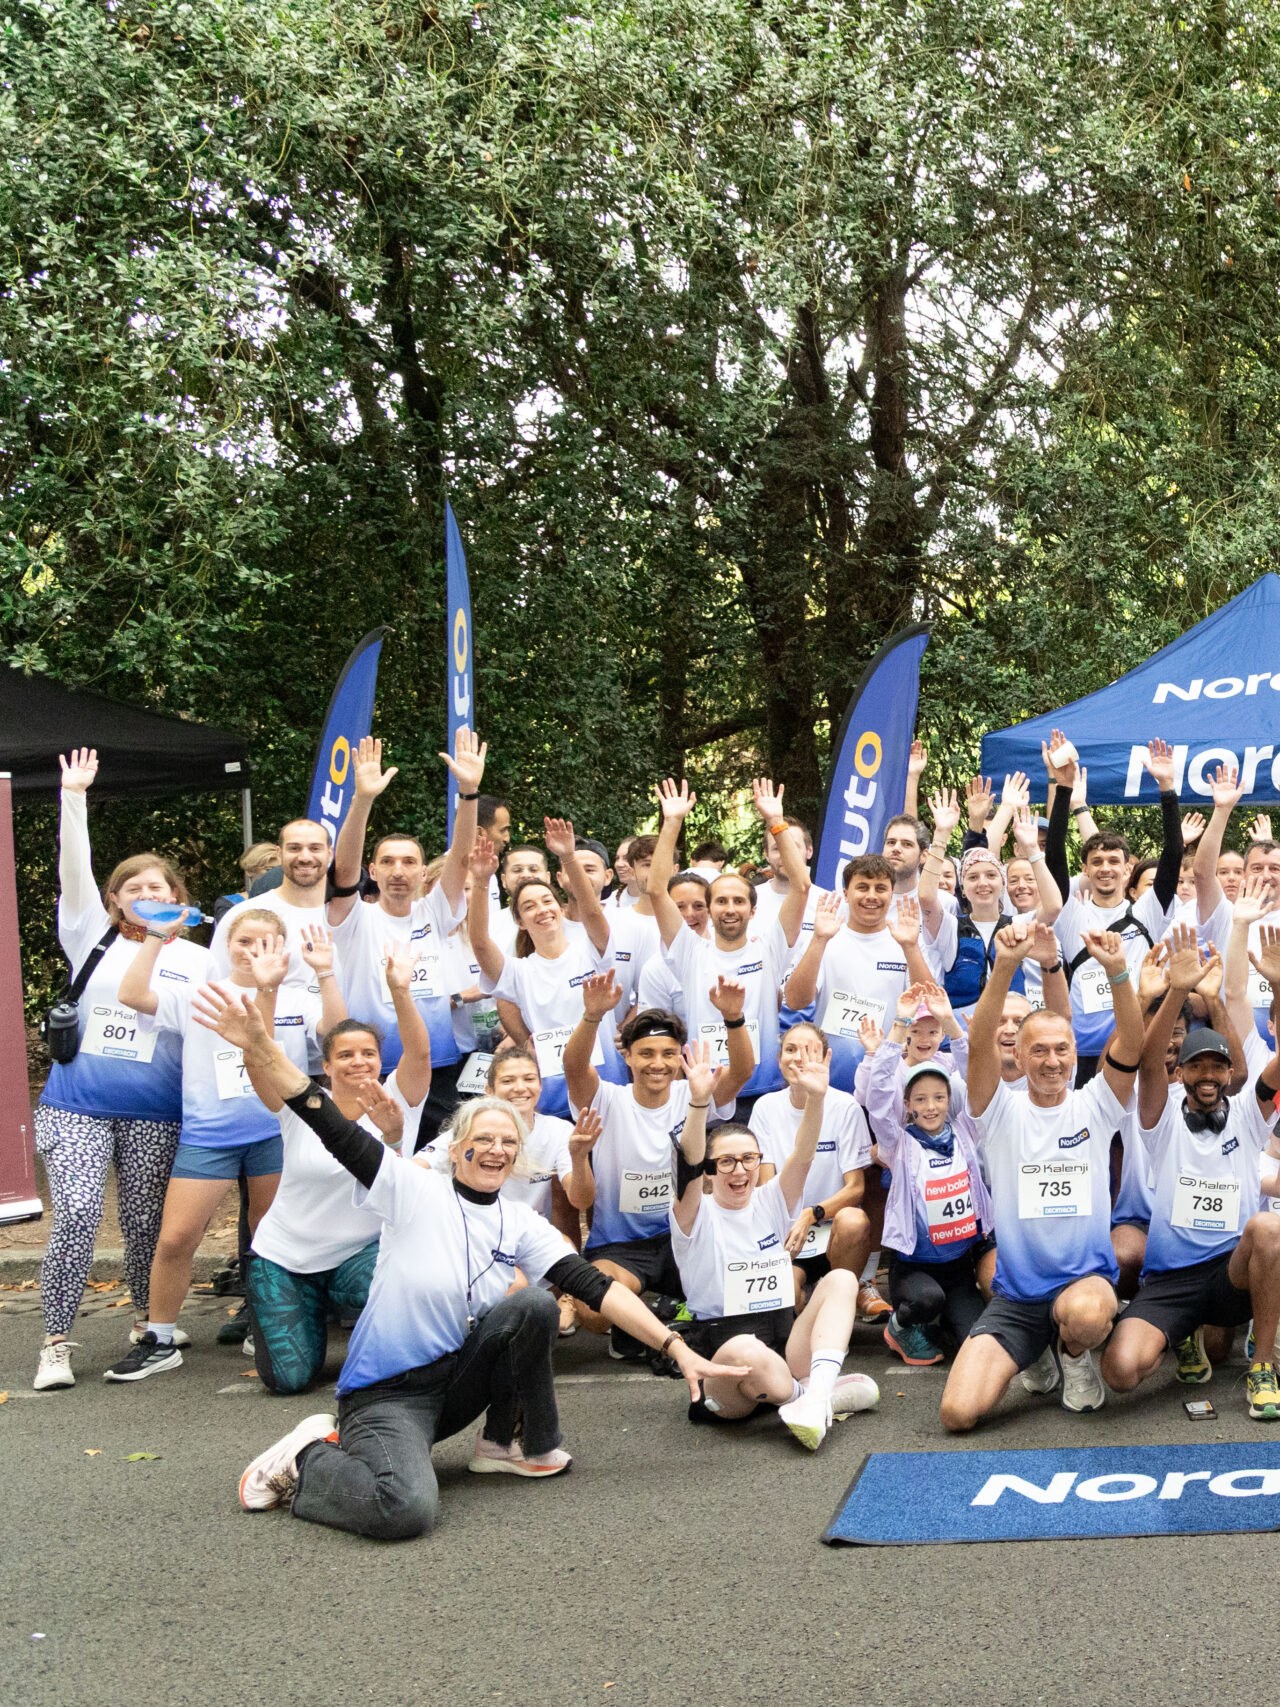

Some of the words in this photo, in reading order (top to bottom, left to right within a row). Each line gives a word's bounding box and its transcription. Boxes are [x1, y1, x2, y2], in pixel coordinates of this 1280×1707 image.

[410, 969, 427, 982] 92
[1097, 983, 1112, 995] 69
[850, 995, 885, 1012] Kalenji
[103, 1025, 137, 1042] 801
[457, 1080, 484, 1090] alenji
[817, 1142, 835, 1151] orau
[1043, 1163, 1088, 1175] Kalenji
[645, 1171, 671, 1181] Kale
[639, 1184, 669, 1199] 642
[927, 1186, 946, 1196] new
[947, 1177, 969, 1192] bala
[1039, 1181, 1072, 1197] 735
[1199, 1179, 1239, 1192] Kalenji
[1193, 1195, 1223, 1212] 738
[932, 1230, 953, 1242] new
[751, 1256, 789, 1270] Kalenji
[745, 1275, 778, 1294] 778
